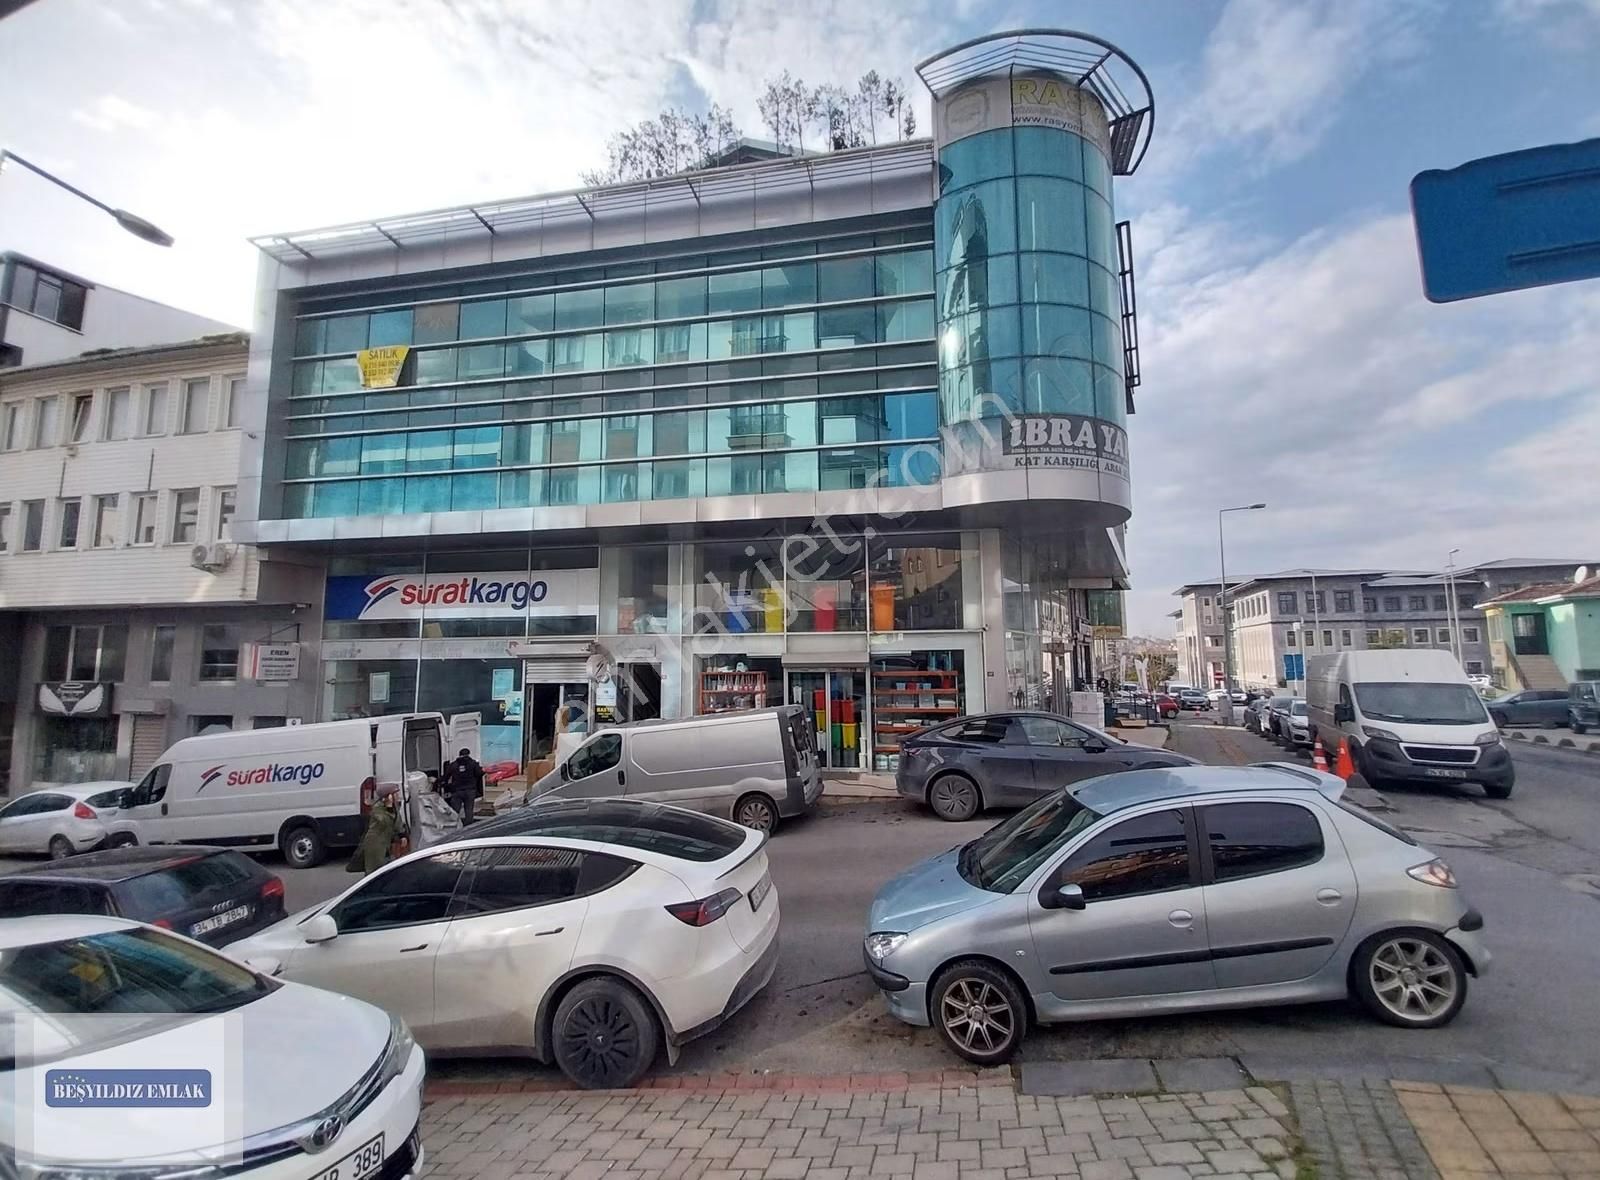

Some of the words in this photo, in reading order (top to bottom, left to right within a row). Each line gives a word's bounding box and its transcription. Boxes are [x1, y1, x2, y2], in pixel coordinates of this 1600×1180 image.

[368, 348, 398, 360] SATILIK
[1101, 425, 1128, 459] YA
[1015, 456, 1041, 467] KAT
[400, 577, 548, 610] süratkargo
[227, 763, 324, 786] süratkargo
[195, 921, 208, 934] 34
[353, 1141, 381, 1178] 389
